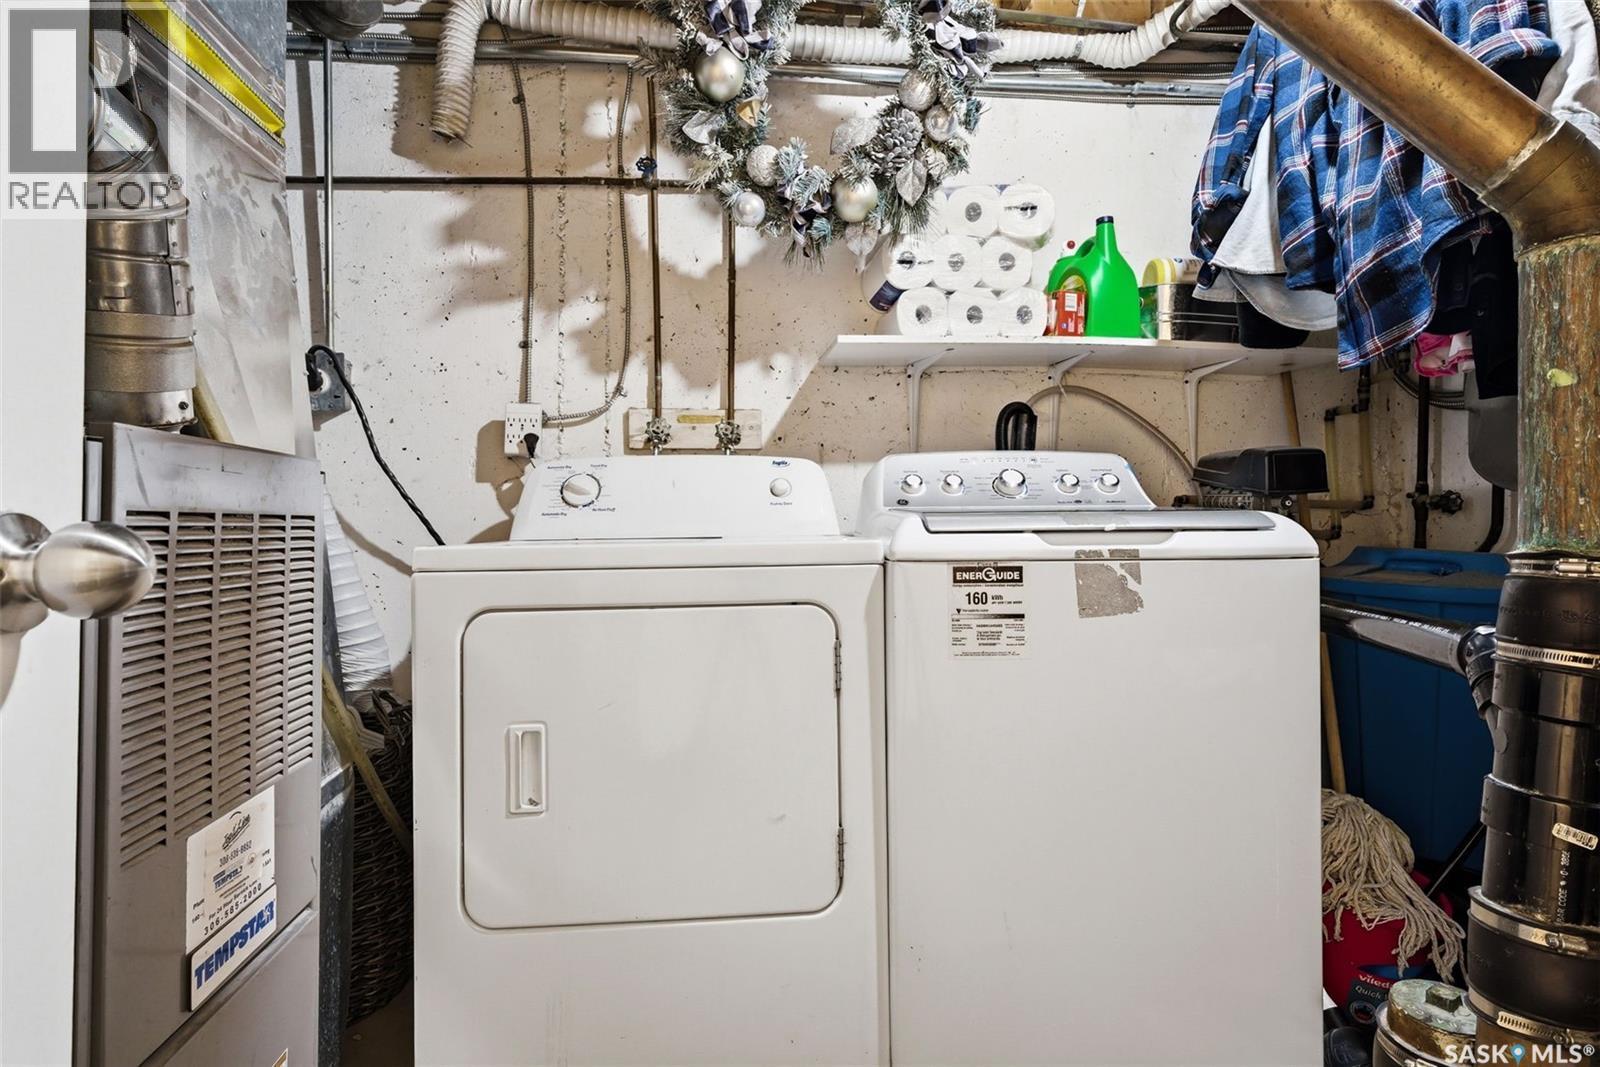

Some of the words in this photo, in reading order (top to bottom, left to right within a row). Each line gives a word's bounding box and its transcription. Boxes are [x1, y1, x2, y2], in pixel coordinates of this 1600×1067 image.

[956, 567, 1020, 582] ENERGUIDE
[965, 592, 988, 605] 160
[204, 883, 263, 936] 306-585-2000
[194, 899, 275, 990] TEMPSTAR
[1355, 985, 1381, 999] Quick
